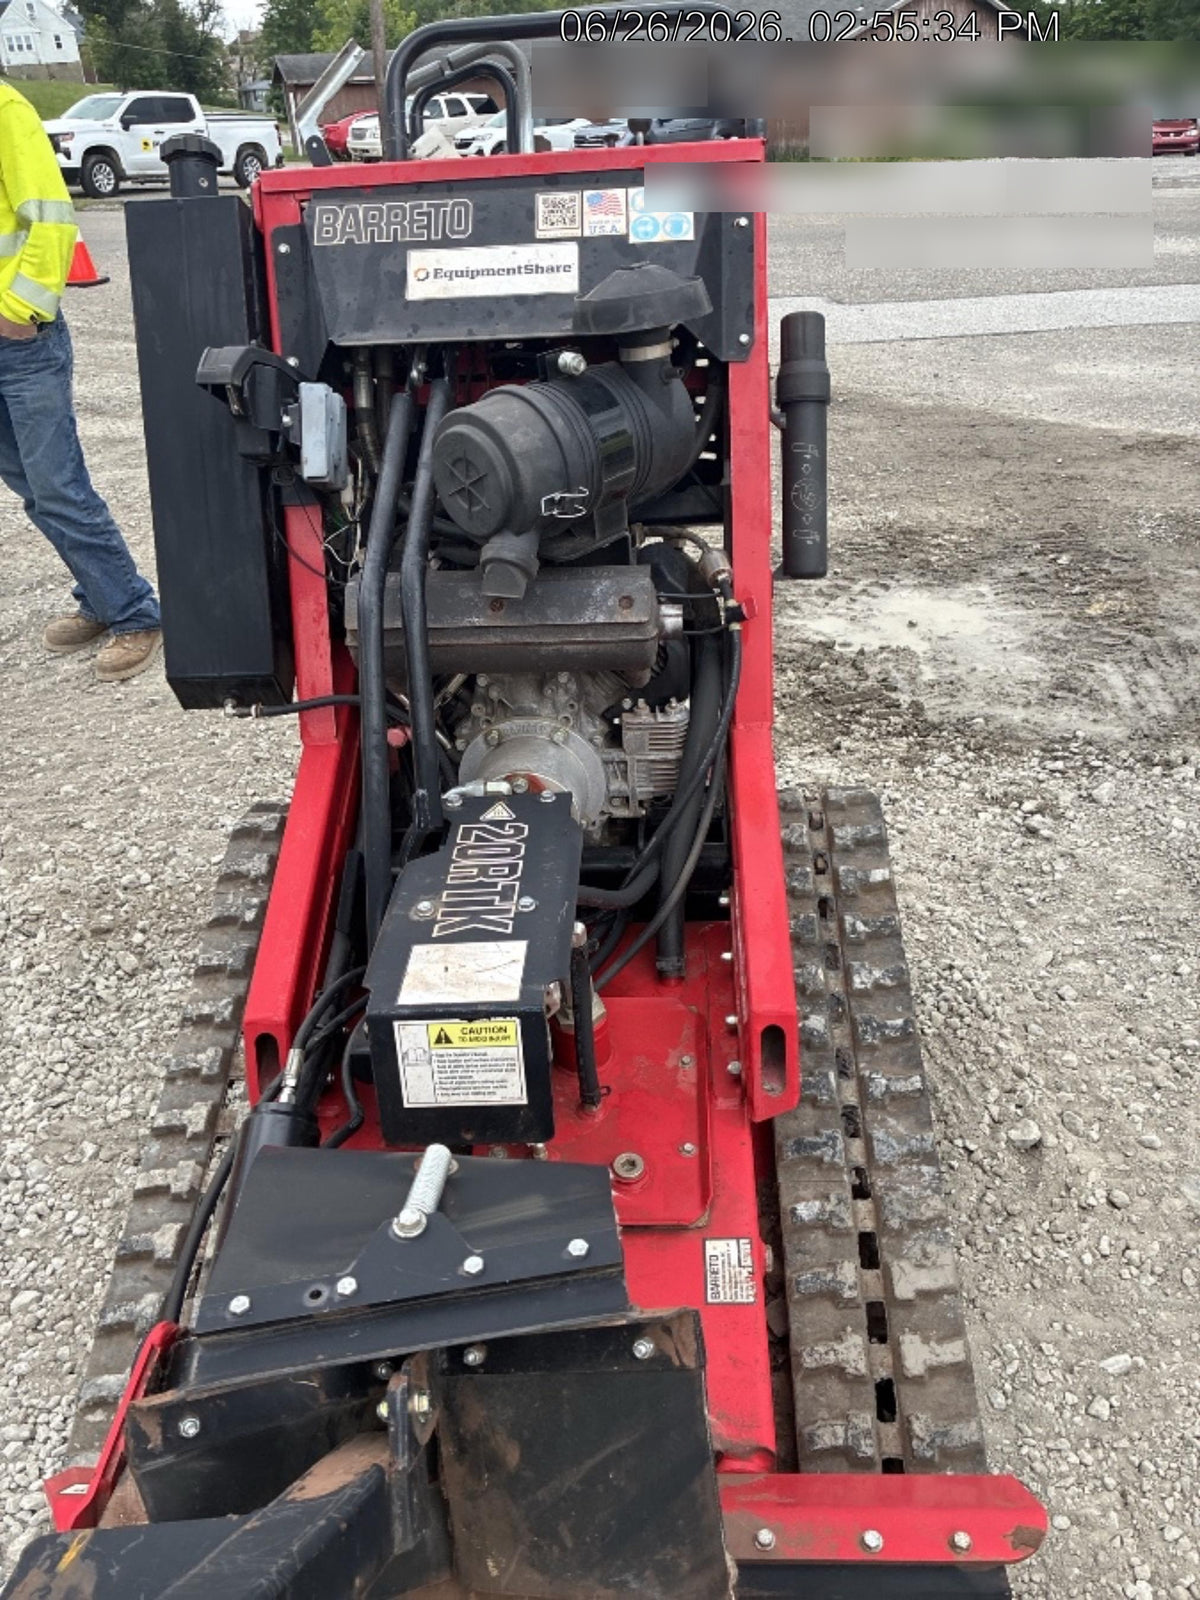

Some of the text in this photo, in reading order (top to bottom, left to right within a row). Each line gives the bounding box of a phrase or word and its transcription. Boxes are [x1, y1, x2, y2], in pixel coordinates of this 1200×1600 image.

[314, 199, 473, 245] BARRETO
[433, 263, 572, 281] EquipmentShare
[431, 823, 528, 937] 20RTK
[460, 1025, 508, 1036] CAUTION
[709, 1254, 720, 1300] BARRETO
